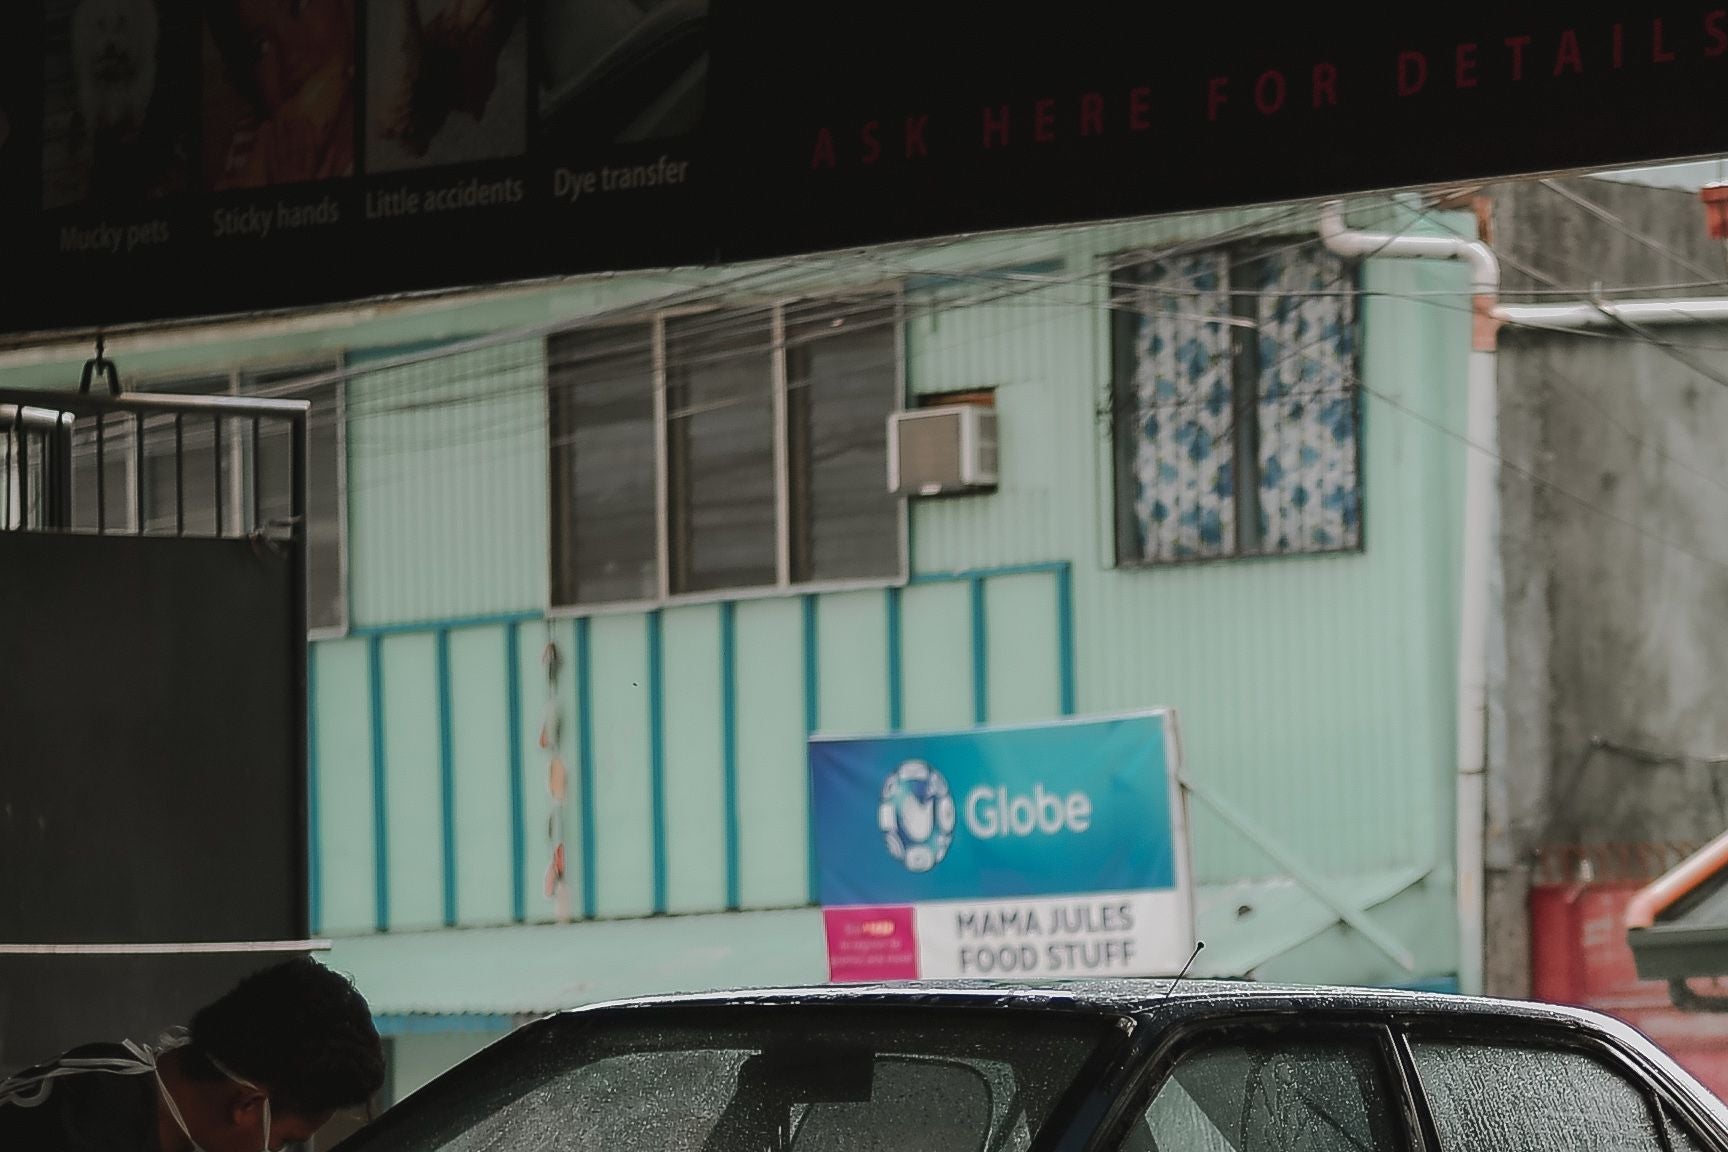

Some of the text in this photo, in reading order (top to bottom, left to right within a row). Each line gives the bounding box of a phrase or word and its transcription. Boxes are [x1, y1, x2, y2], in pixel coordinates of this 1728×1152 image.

[810, 9, 1728, 170] ASK HERE FOR DETAILS
[366, 176, 523, 218] Little accidents
[554, 155, 687, 202] Dye transfer
[60, 219, 169, 254] Mucky pets
[212, 196, 339, 238] Sticky hands
[965, 784, 1093, 838] Globe
[956, 903, 1134, 938] MAMA JULES
[959, 940, 1136, 974] FOOD STUFF
